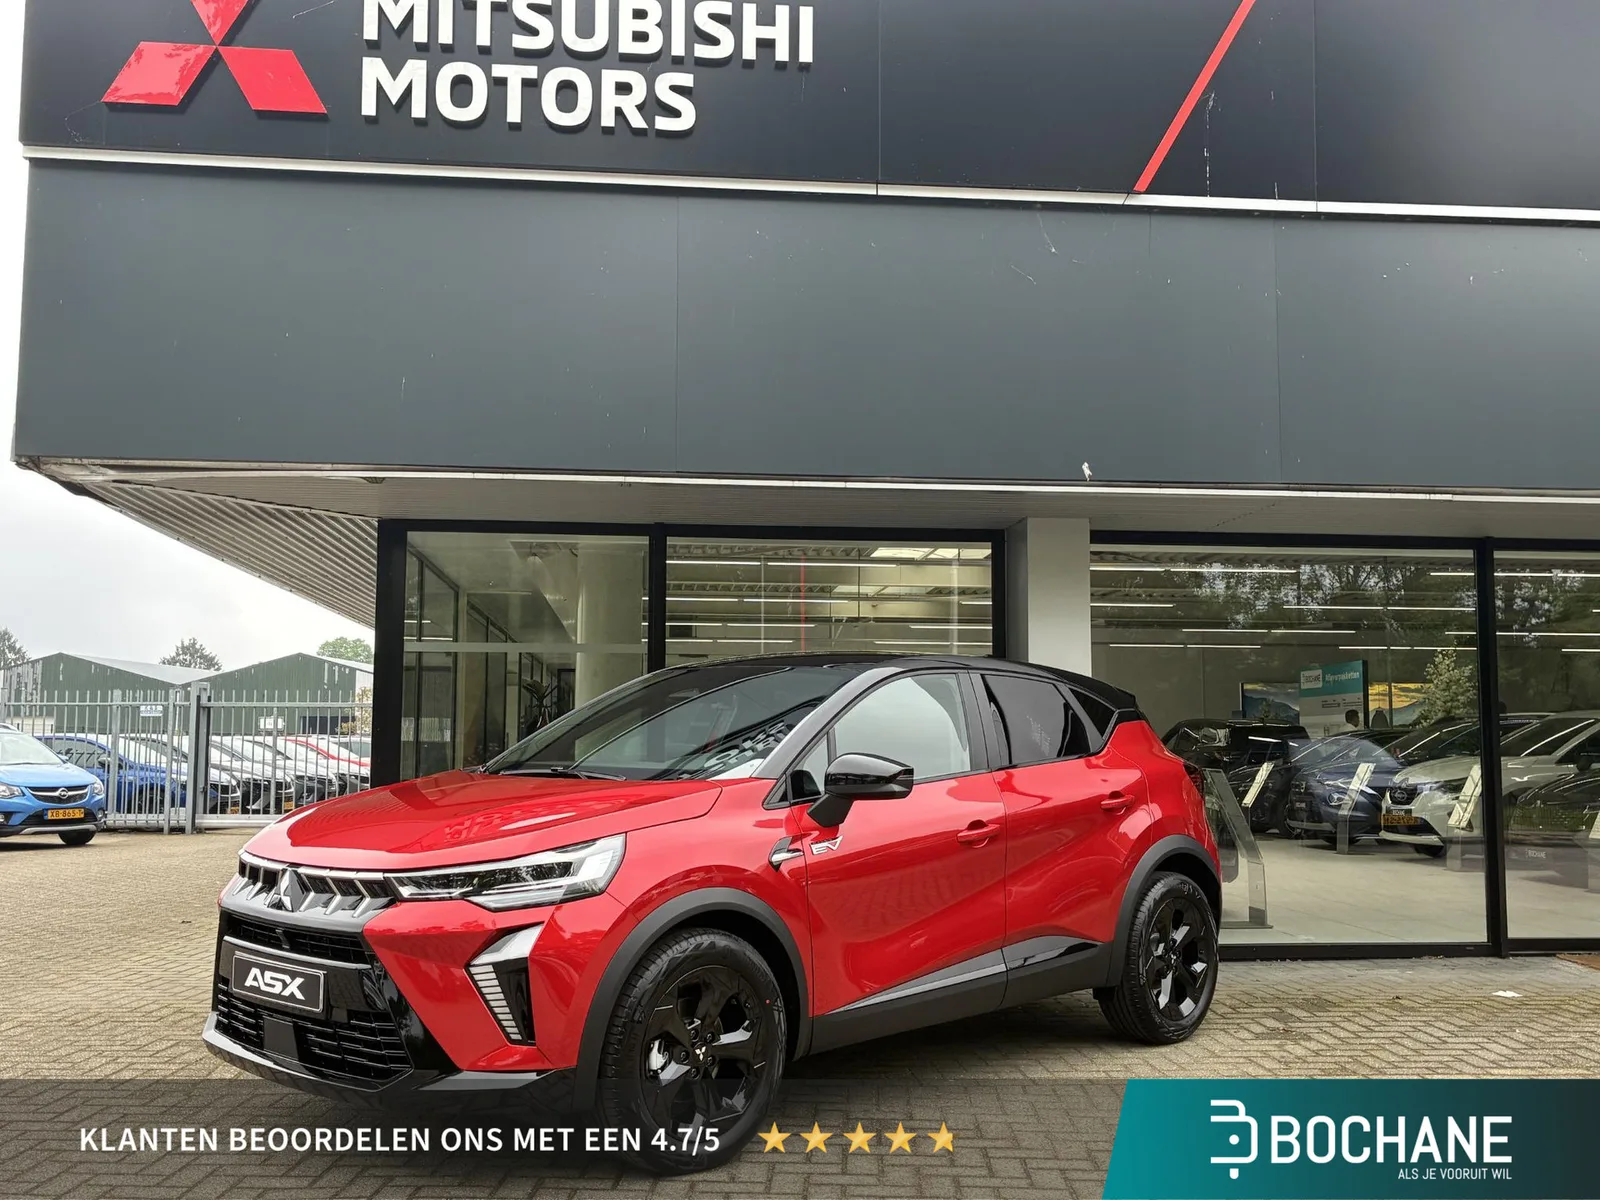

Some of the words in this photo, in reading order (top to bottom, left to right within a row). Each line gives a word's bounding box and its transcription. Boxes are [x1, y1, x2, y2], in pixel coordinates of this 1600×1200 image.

[362, 0, 814, 63] MITSUBISHI
[361, 57, 698, 132] MOTORS
[244, 967, 306, 1001] ASX
